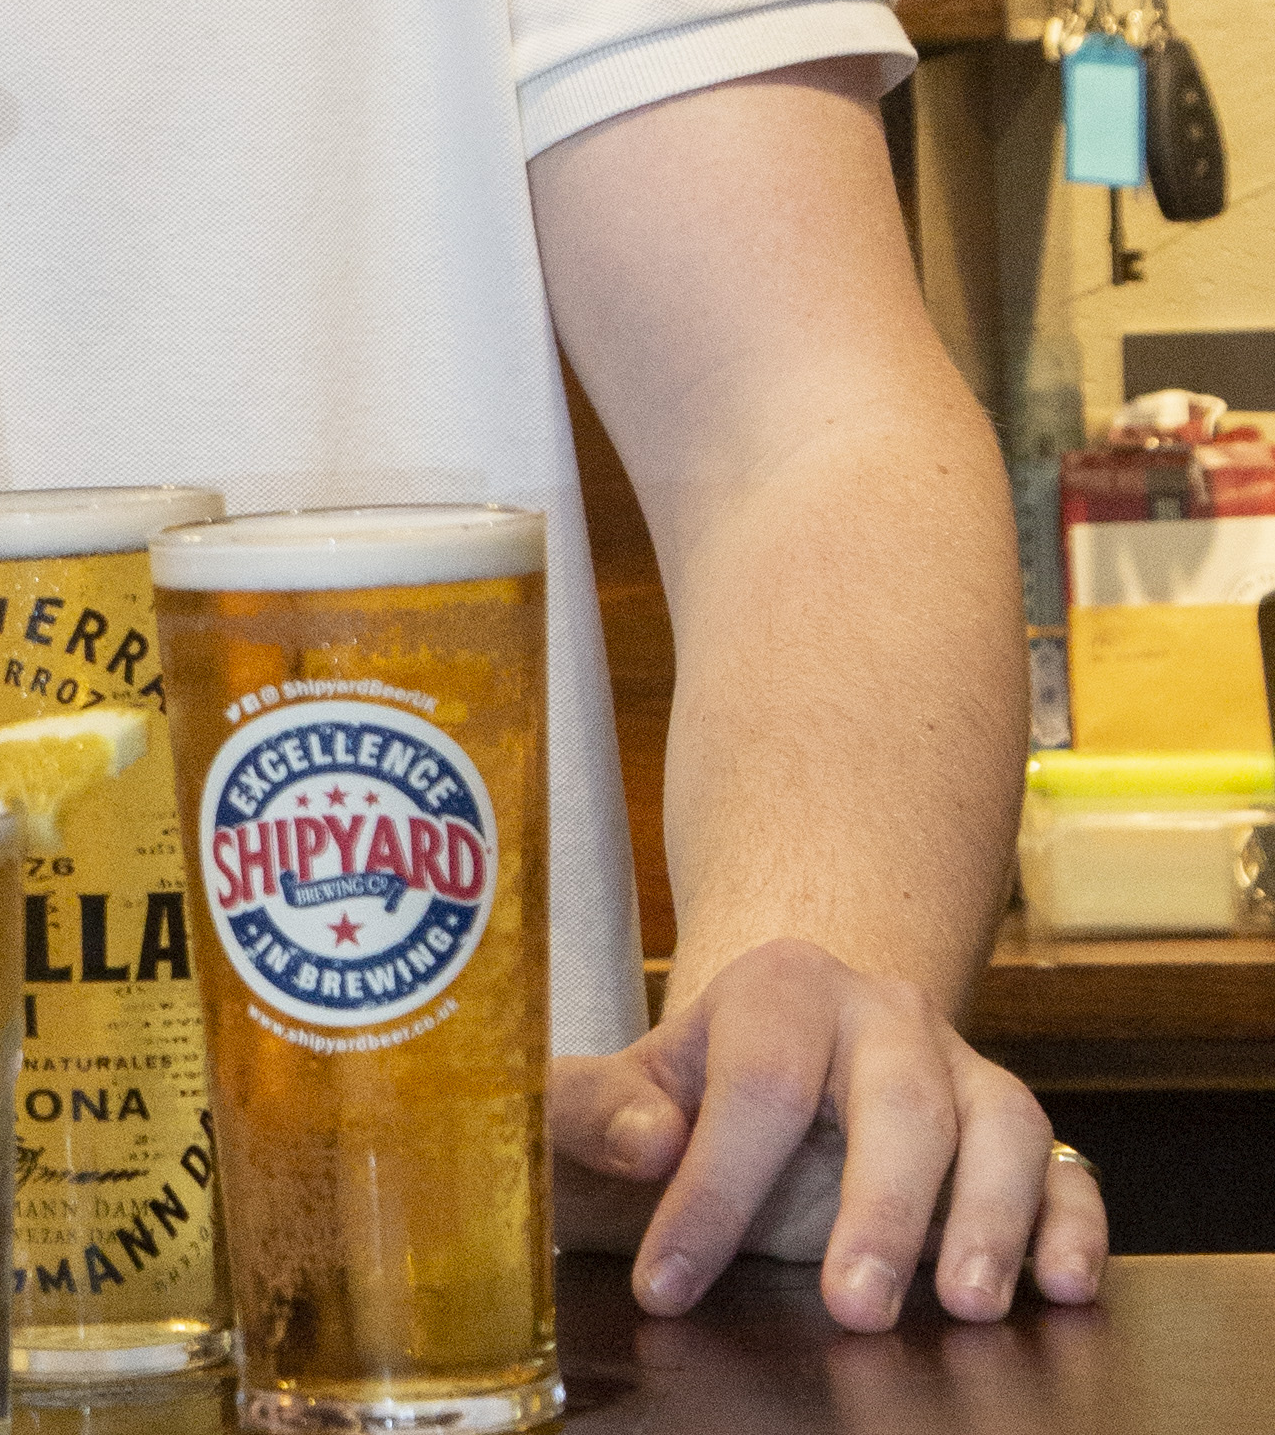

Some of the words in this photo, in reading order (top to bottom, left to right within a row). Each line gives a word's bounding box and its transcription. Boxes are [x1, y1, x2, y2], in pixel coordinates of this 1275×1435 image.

[228, 731, 457, 817] EXCELLENCE
[212, 813, 487, 911] SHIPYARD
[298, 879, 367, 906] BREWING
[294, 927, 453, 999] BREWING
[22, 1054, 173, 1073] NATURALES
